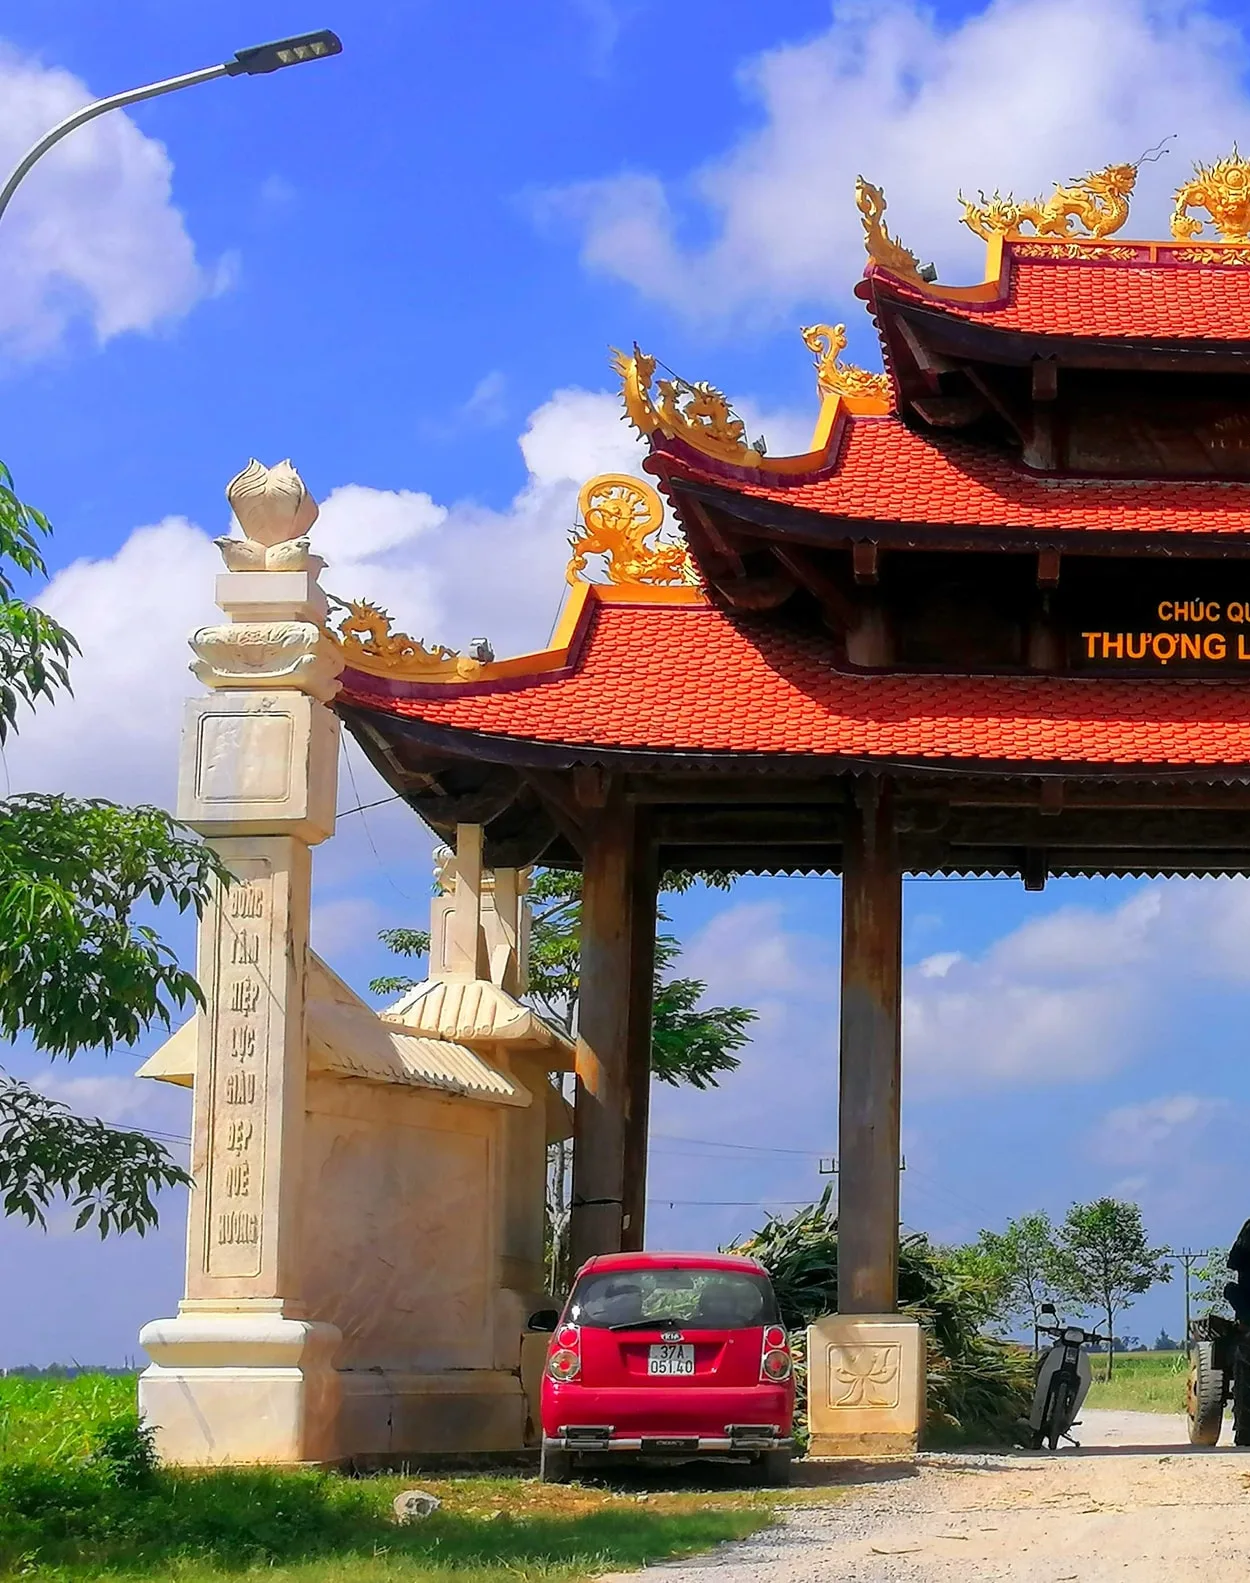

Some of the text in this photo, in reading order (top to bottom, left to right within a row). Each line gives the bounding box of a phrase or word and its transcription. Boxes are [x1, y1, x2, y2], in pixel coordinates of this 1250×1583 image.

[1158, 597, 1220, 622] CHÚC
[1082, 632, 1227, 665] THƯỢNG
[660, 1345, 684, 1359] 37A
[651, 1360, 693, 1374] 051.40
